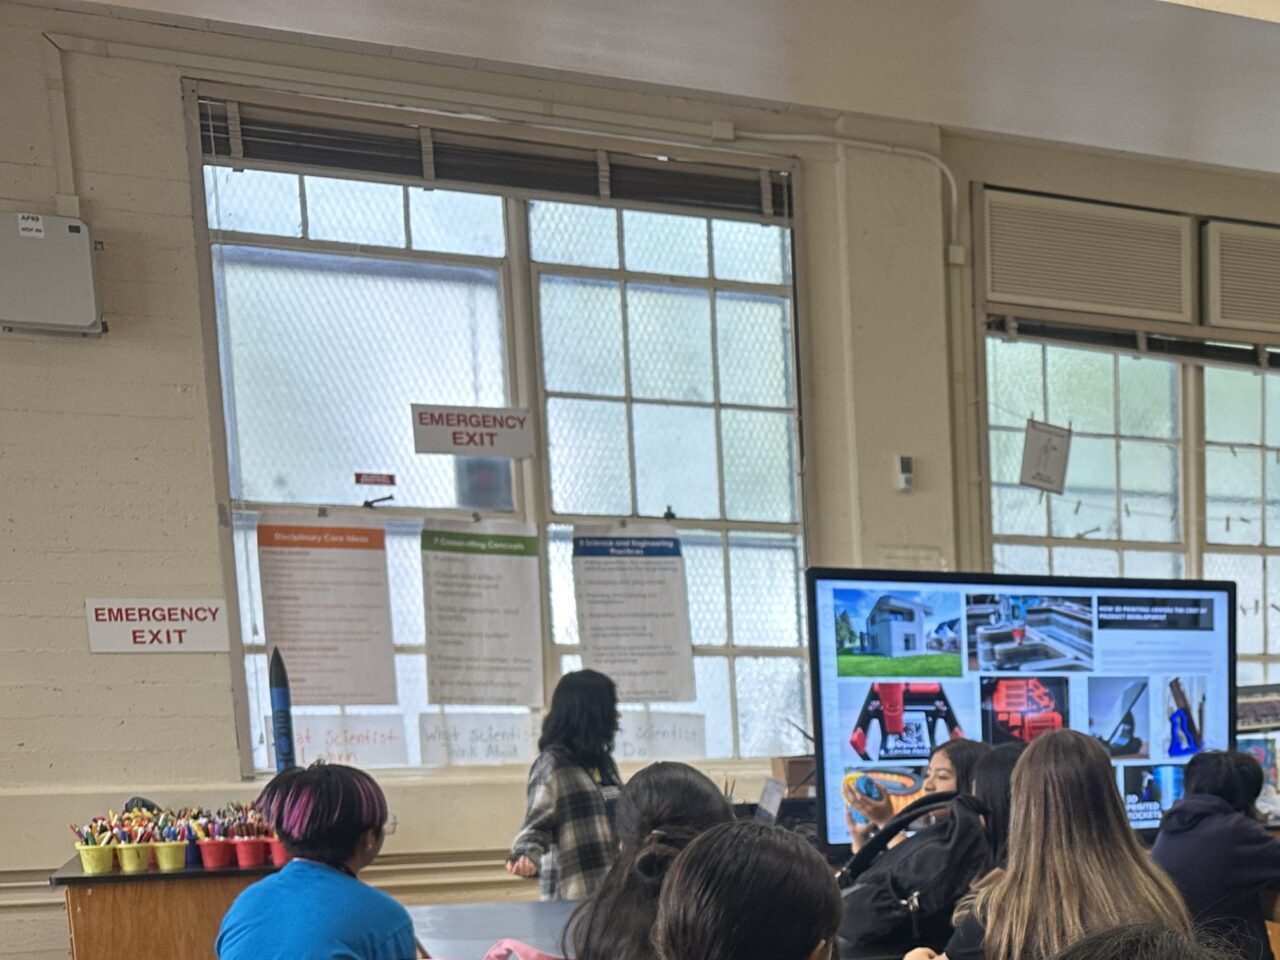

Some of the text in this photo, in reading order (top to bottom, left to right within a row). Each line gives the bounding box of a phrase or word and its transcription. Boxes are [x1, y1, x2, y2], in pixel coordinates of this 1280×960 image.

[418, 411, 527, 430] EMERGENCY
[452, 431, 498, 447] EXIT
[94, 607, 219, 622] EMERGENCY
[132, 629, 187, 645] EXIT
